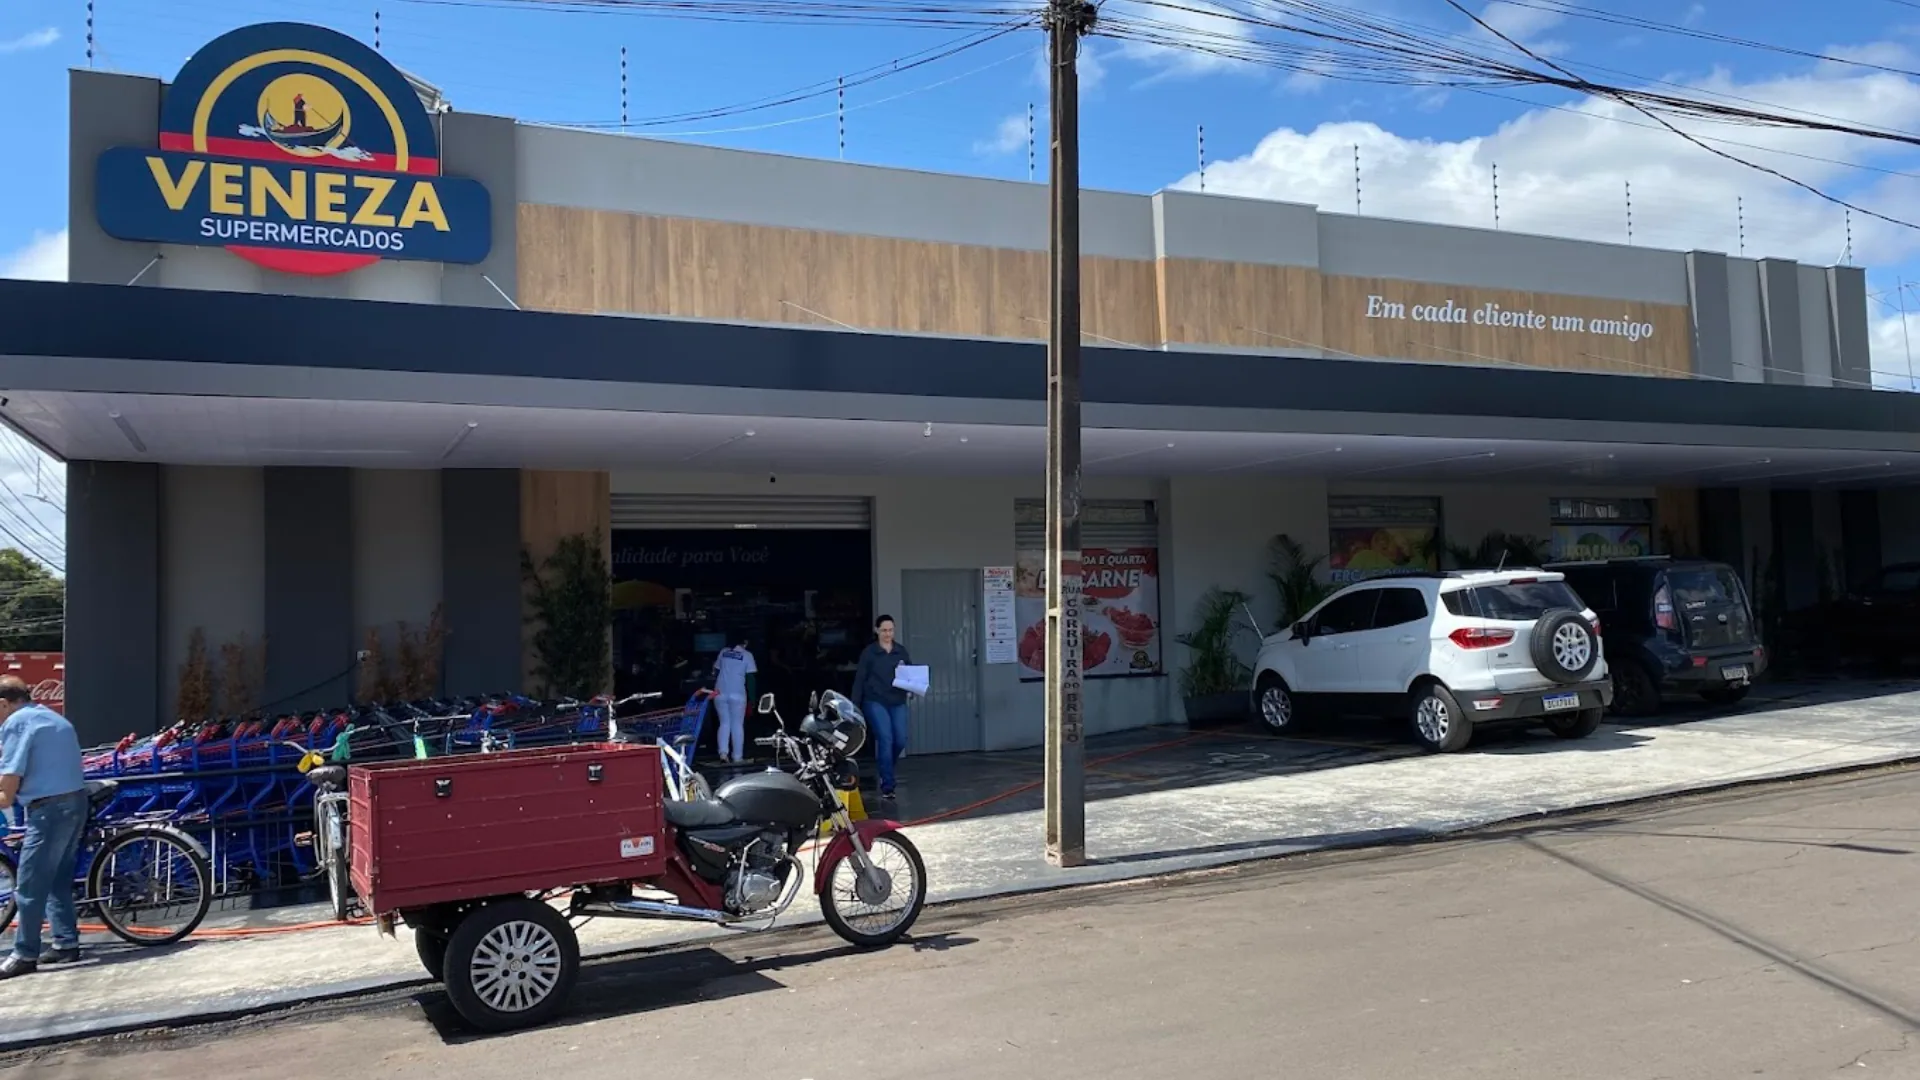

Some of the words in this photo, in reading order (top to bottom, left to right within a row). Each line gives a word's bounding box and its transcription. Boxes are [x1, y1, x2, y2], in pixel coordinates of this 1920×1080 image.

[145, 156, 451, 232] VENEZA
[200, 218, 405, 252] SUPERMERCADOS
[1365, 295, 1406, 320] Em
[1411, 300, 1467, 324] cada
[1473, 303, 1546, 330] cliente
[1550, 315, 1585, 333] um
[1589, 315, 1654, 342] amigo
[611, 545, 678, 564] alidade
[679, 549, 724, 568] para
[1099, 555, 1106, 565] E
[1107, 555, 1147, 566] QUARTA
[1066, 599, 1077, 678] CORRUIRA
